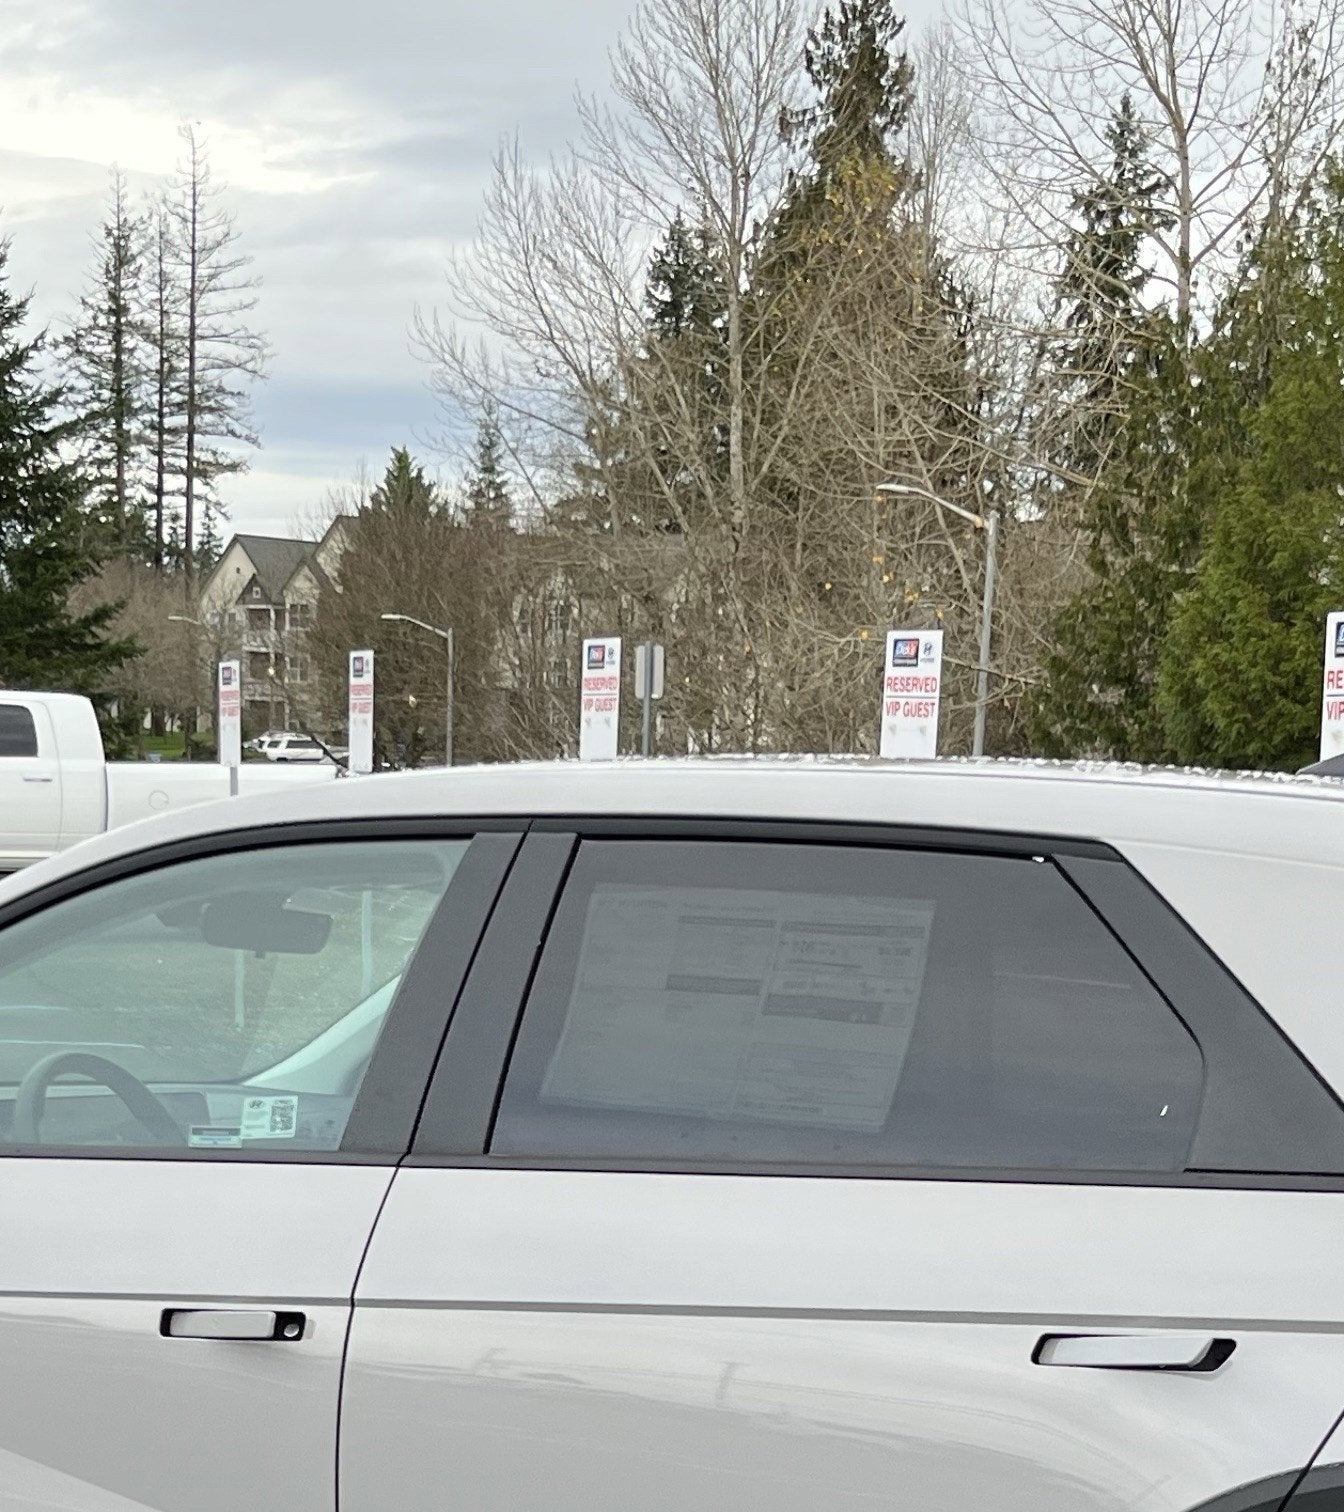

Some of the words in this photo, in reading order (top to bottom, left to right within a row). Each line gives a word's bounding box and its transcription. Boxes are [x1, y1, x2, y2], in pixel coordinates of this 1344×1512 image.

[886, 676, 937, 693] RESERVED
[885, 701, 900, 717] VIP
[902, 701, 936, 718] GUEST
